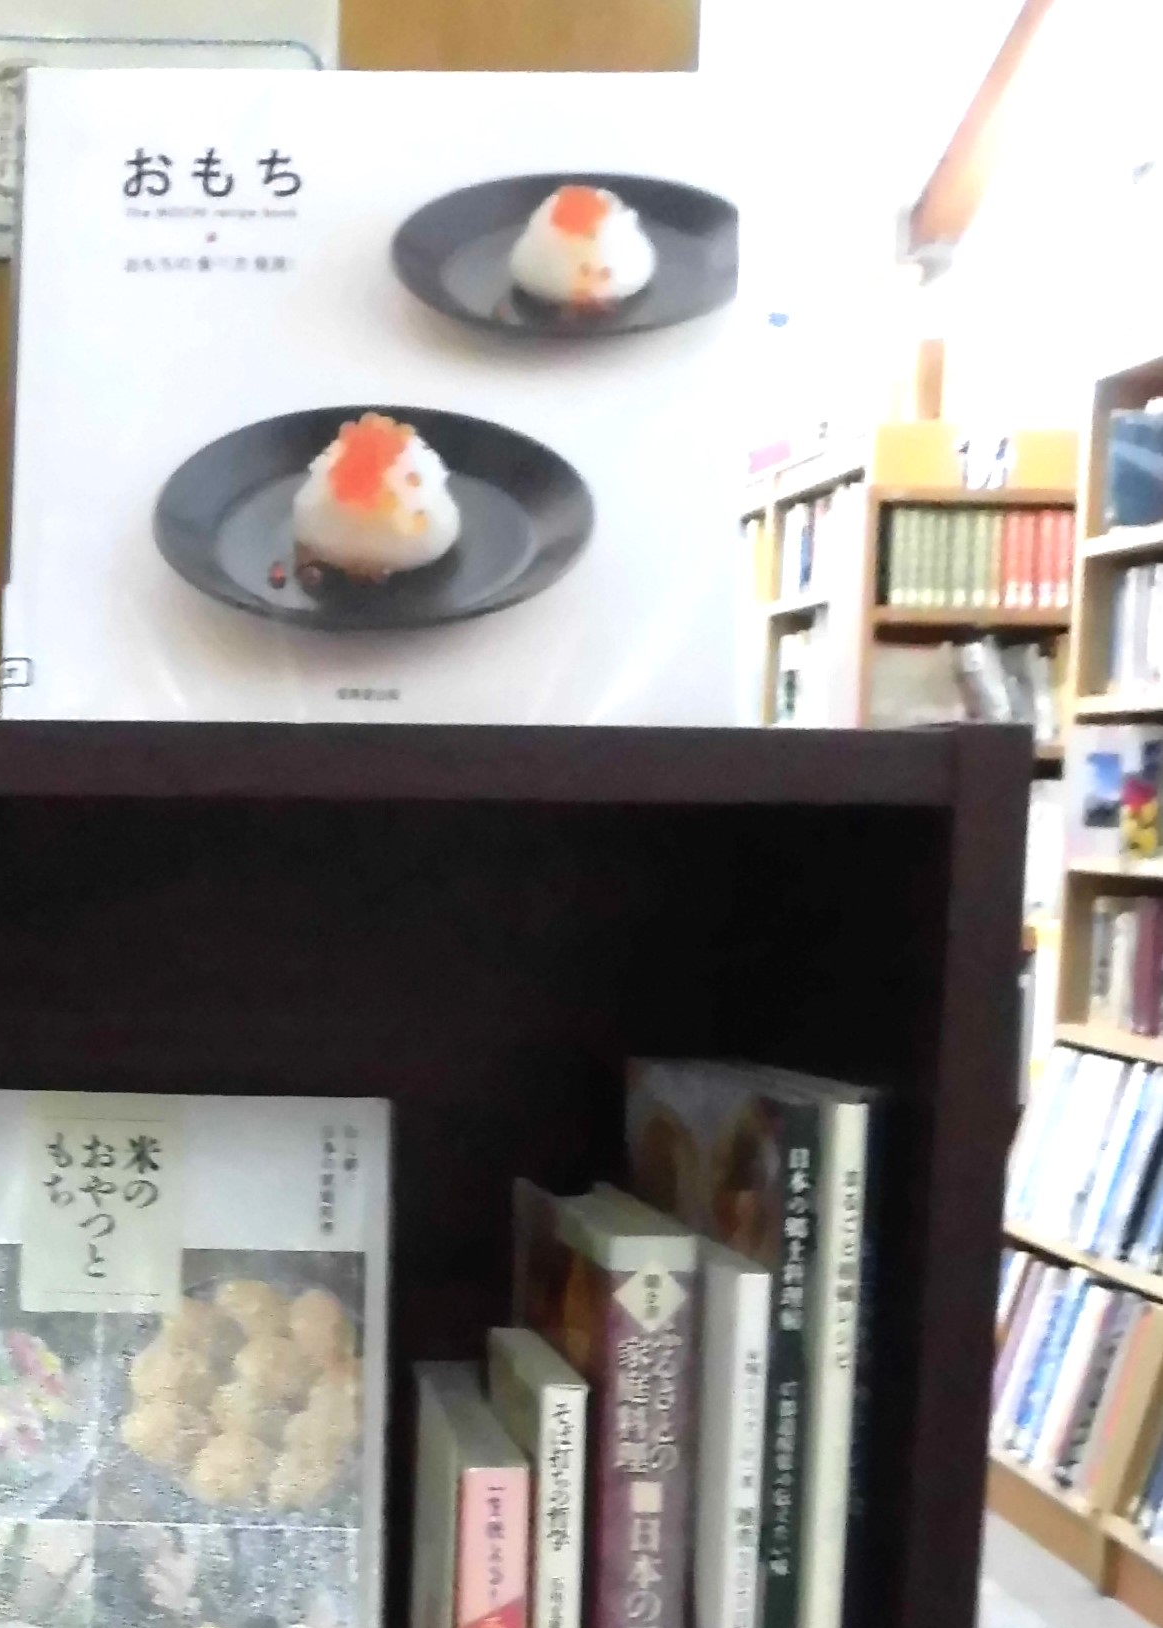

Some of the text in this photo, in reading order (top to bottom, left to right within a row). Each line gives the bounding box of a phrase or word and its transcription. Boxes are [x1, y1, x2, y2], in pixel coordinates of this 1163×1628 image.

[123, 147, 302, 198] おもち
[44, 1132, 75, 1208] もち
[78, 1134, 117, 1279] おやつと
[121, 1133, 161, 1211] 米の
